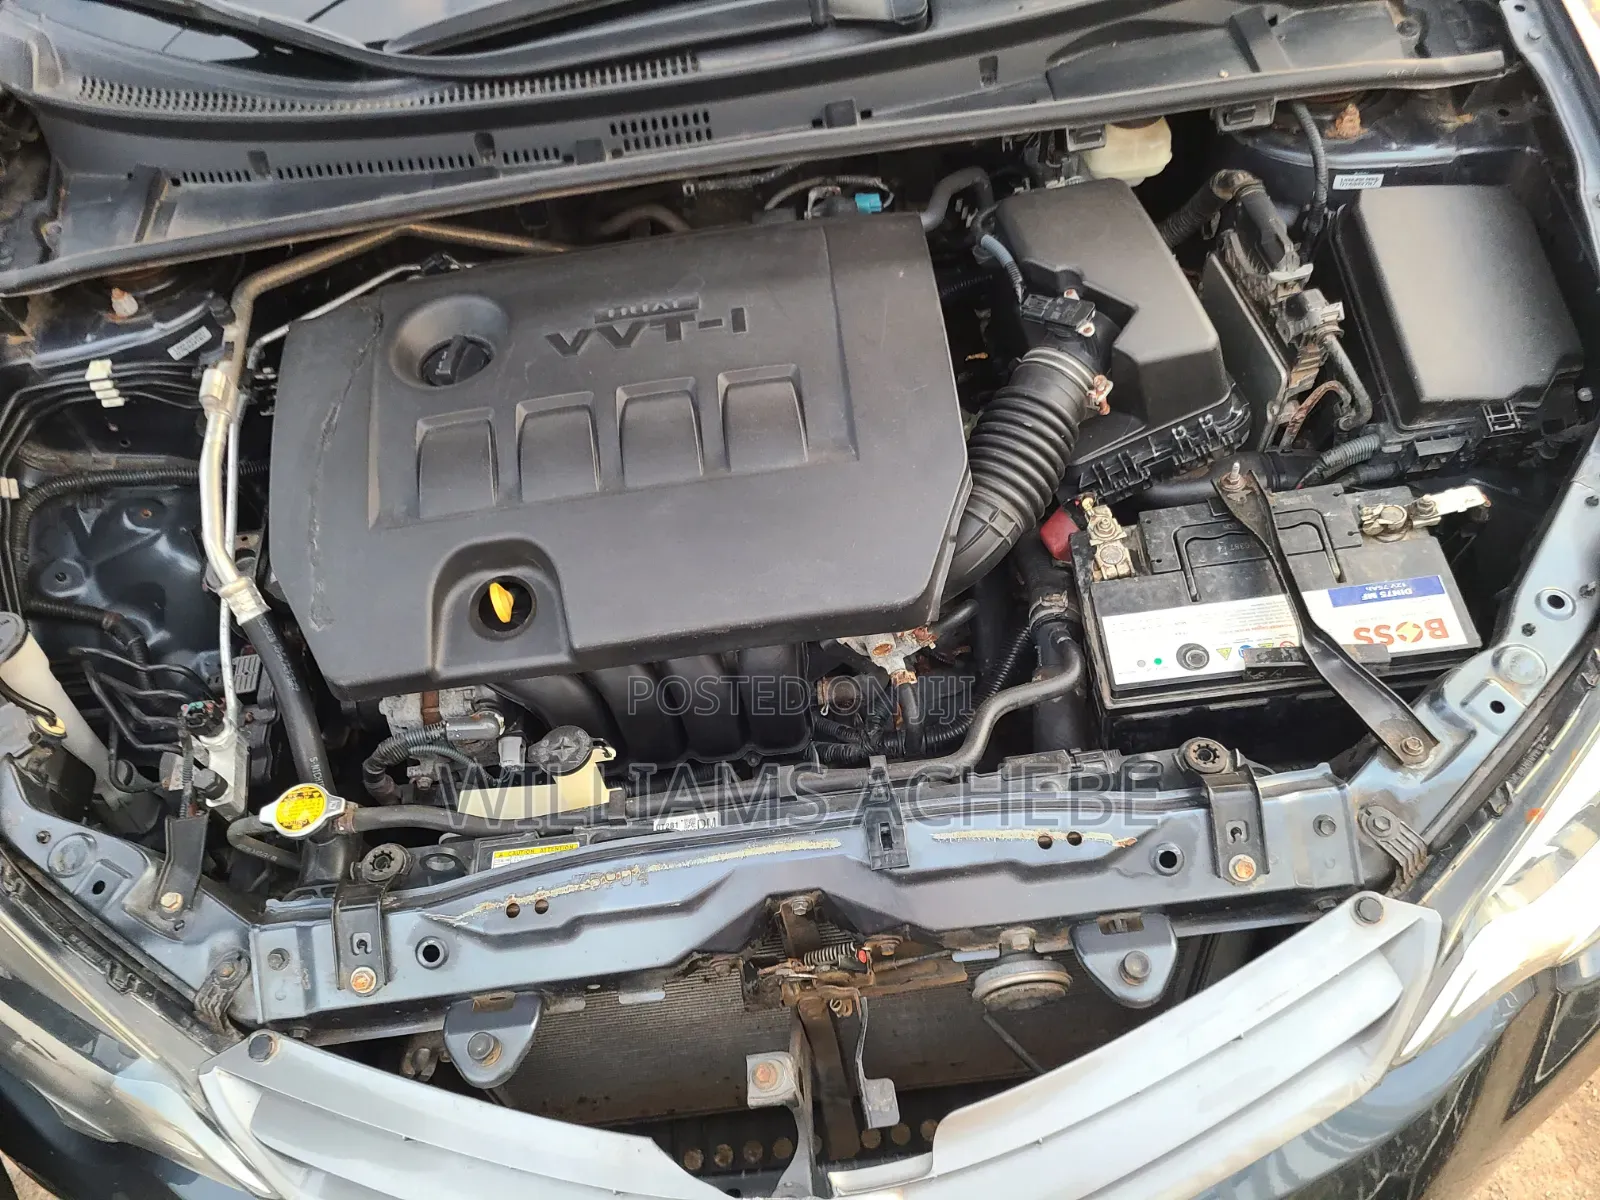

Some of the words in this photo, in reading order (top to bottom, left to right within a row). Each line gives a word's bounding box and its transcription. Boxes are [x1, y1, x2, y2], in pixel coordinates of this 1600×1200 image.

[1380, 588, 1413, 598] DIN75
[1353, 618, 1449, 646] BOSS
[508, 849, 535, 857] CAUTION
[540, 845, 574, 853] ATTENTION
